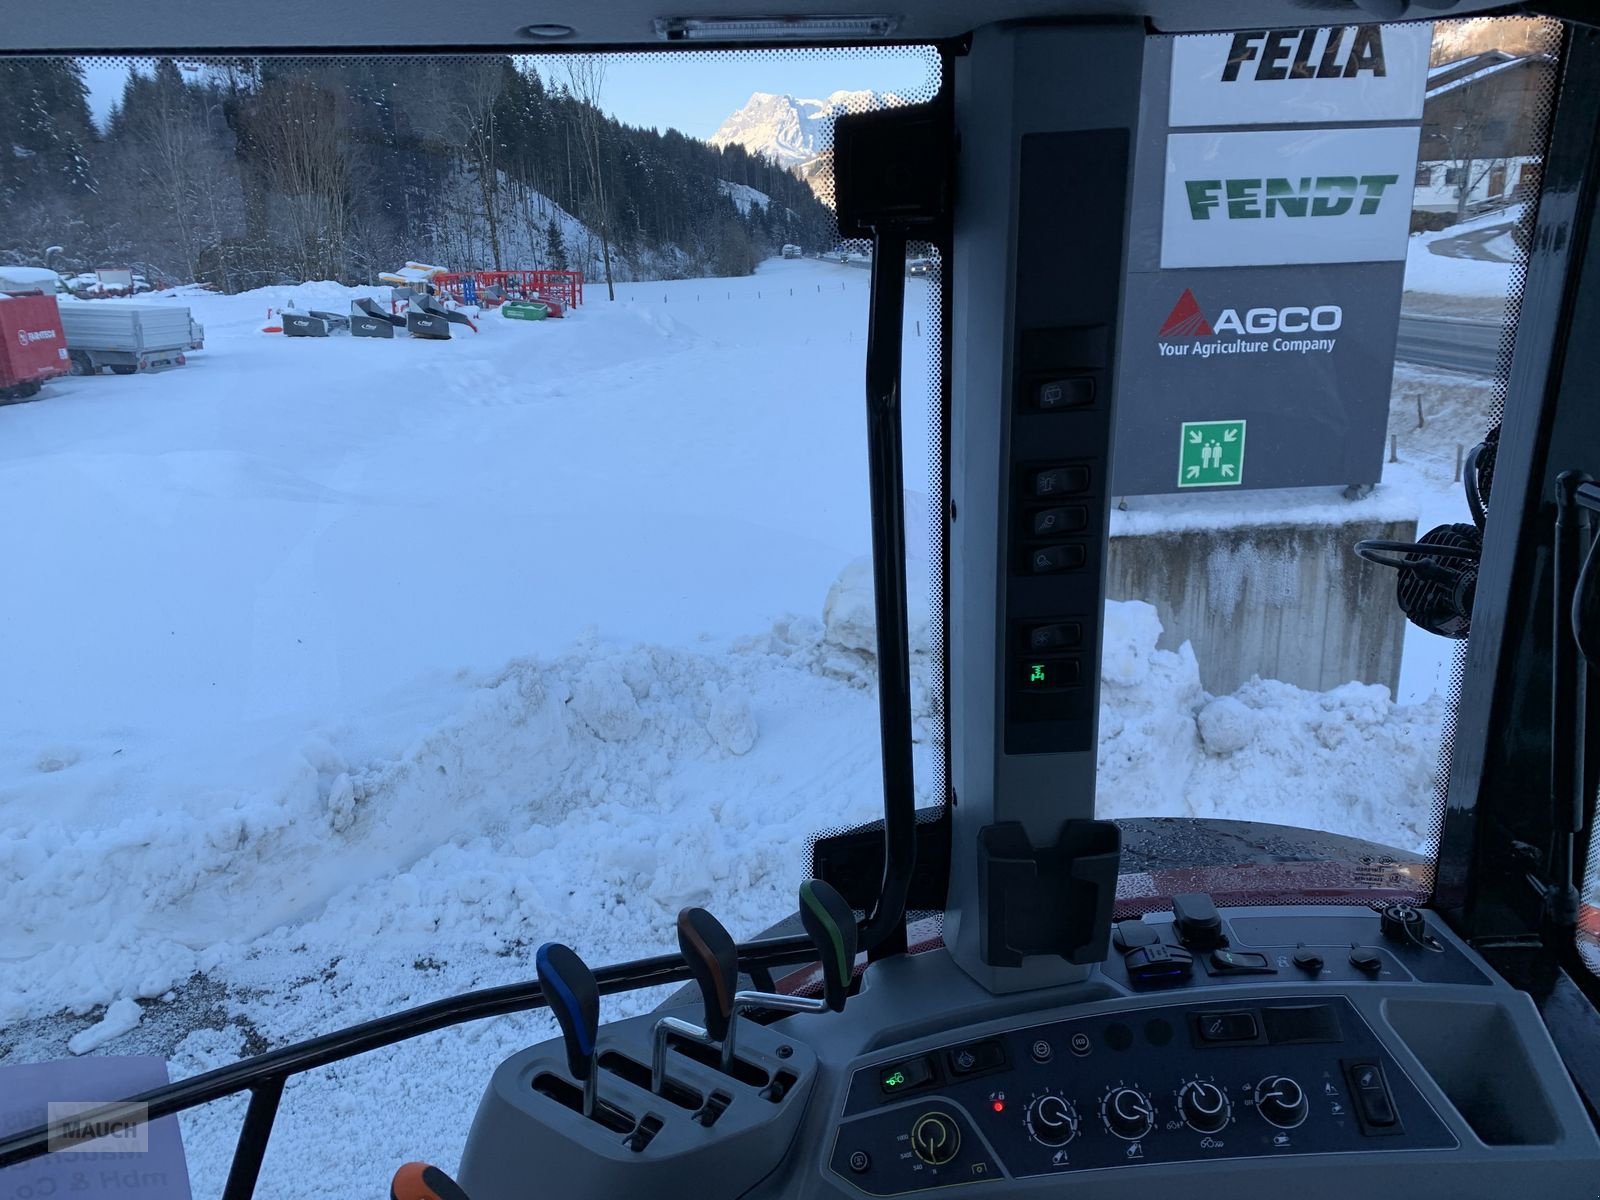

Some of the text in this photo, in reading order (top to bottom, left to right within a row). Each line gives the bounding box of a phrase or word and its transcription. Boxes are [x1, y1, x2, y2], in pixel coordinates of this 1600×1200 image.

[1221, 26, 1387, 81] FELLA
[1184, 174, 1400, 220] FENDT
[1212, 305, 1343, 335] AGCO
[1158, 337, 1337, 358] Your Agriculture Company
